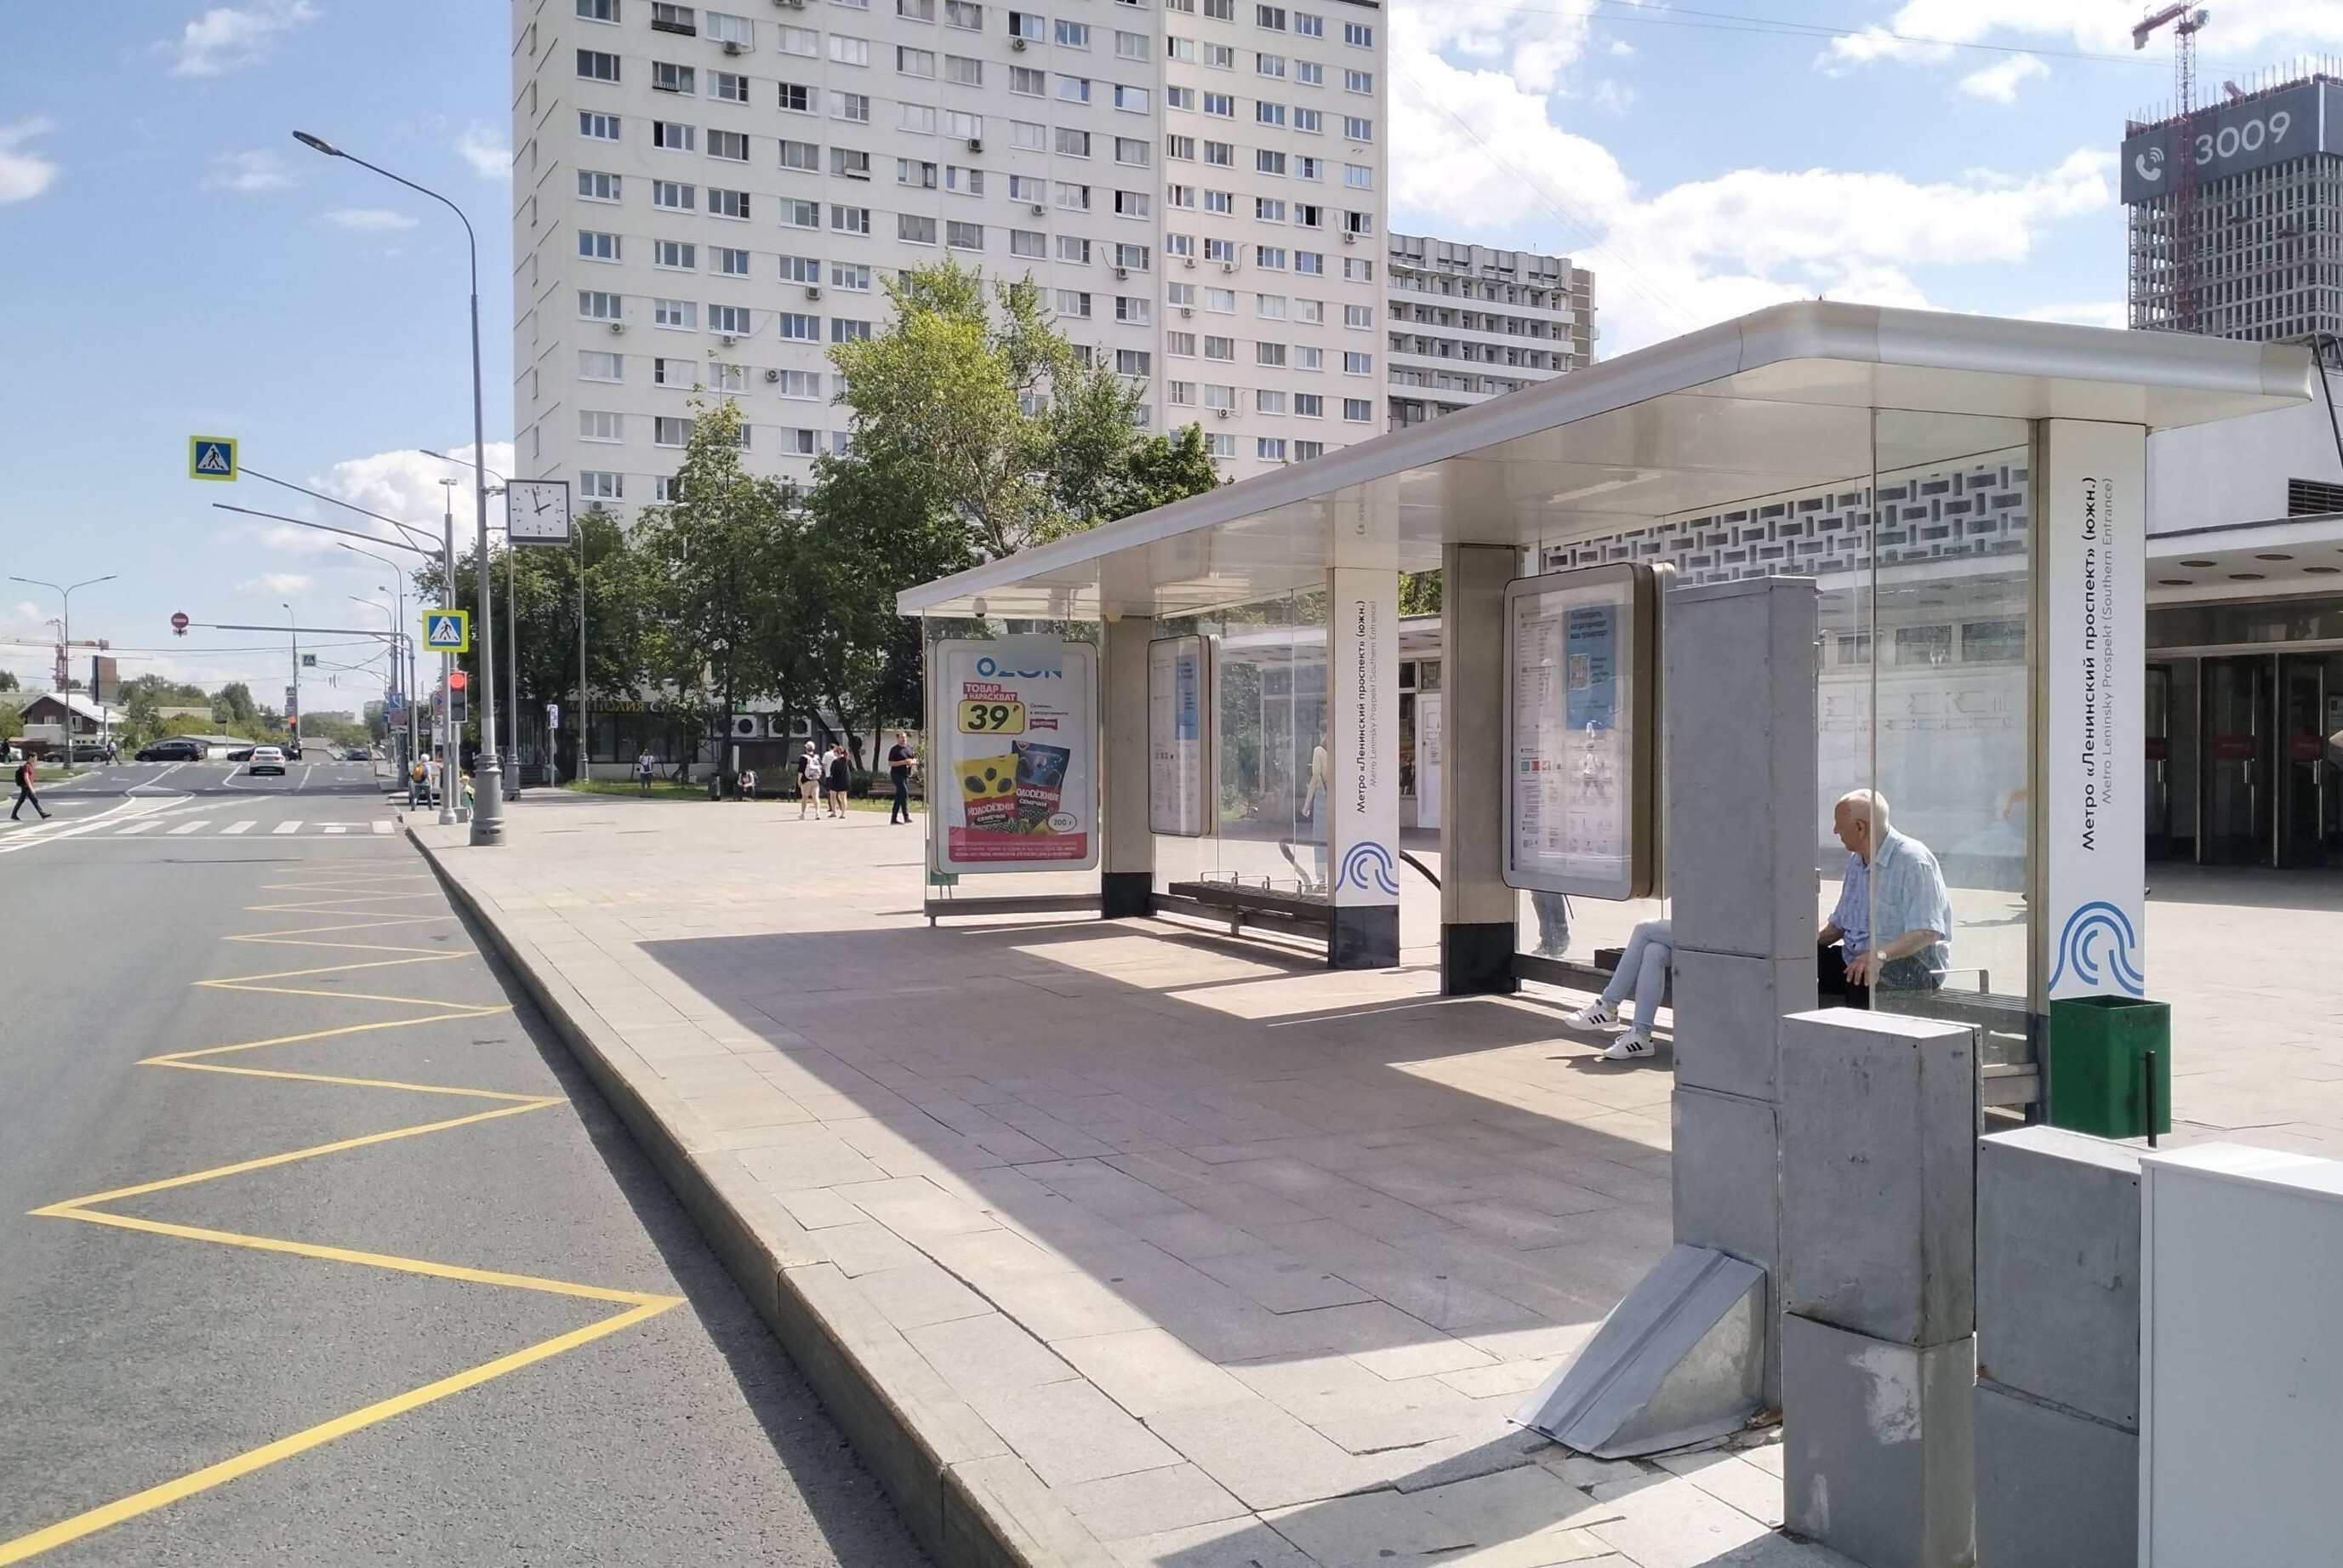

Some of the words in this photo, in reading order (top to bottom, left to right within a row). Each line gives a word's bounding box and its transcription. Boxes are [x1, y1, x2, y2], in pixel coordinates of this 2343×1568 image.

[2195, 111, 2291, 166] 3009
[2081, 476, 2097, 541] (южн.)
[2101, 477, 2113, 545] Entrance)
[2085, 548, 2097, 651] проспект»
[2101, 550, 2113, 621] (Southern
[1355, 600, 1366, 637] (южн.)
[1359, 641, 1367, 700] проспект»
[2101, 624, 2114, 688] Prospekt
[966, 684, 999, 693] ТОВАР
[969, 693, 1016, 702] НАРАСХВАТ
[2082, 658, 2095, 777] «Ленинский
[1357, 703, 1366, 772] «Ленинский
[2102, 692, 2114, 755] Leninsky
[1357, 774, 1367, 813] Метро
[2102, 760, 2112, 804] Metro
[1053, 818, 1067, 826] 200
[2083, 784, 2098, 852] Метро
